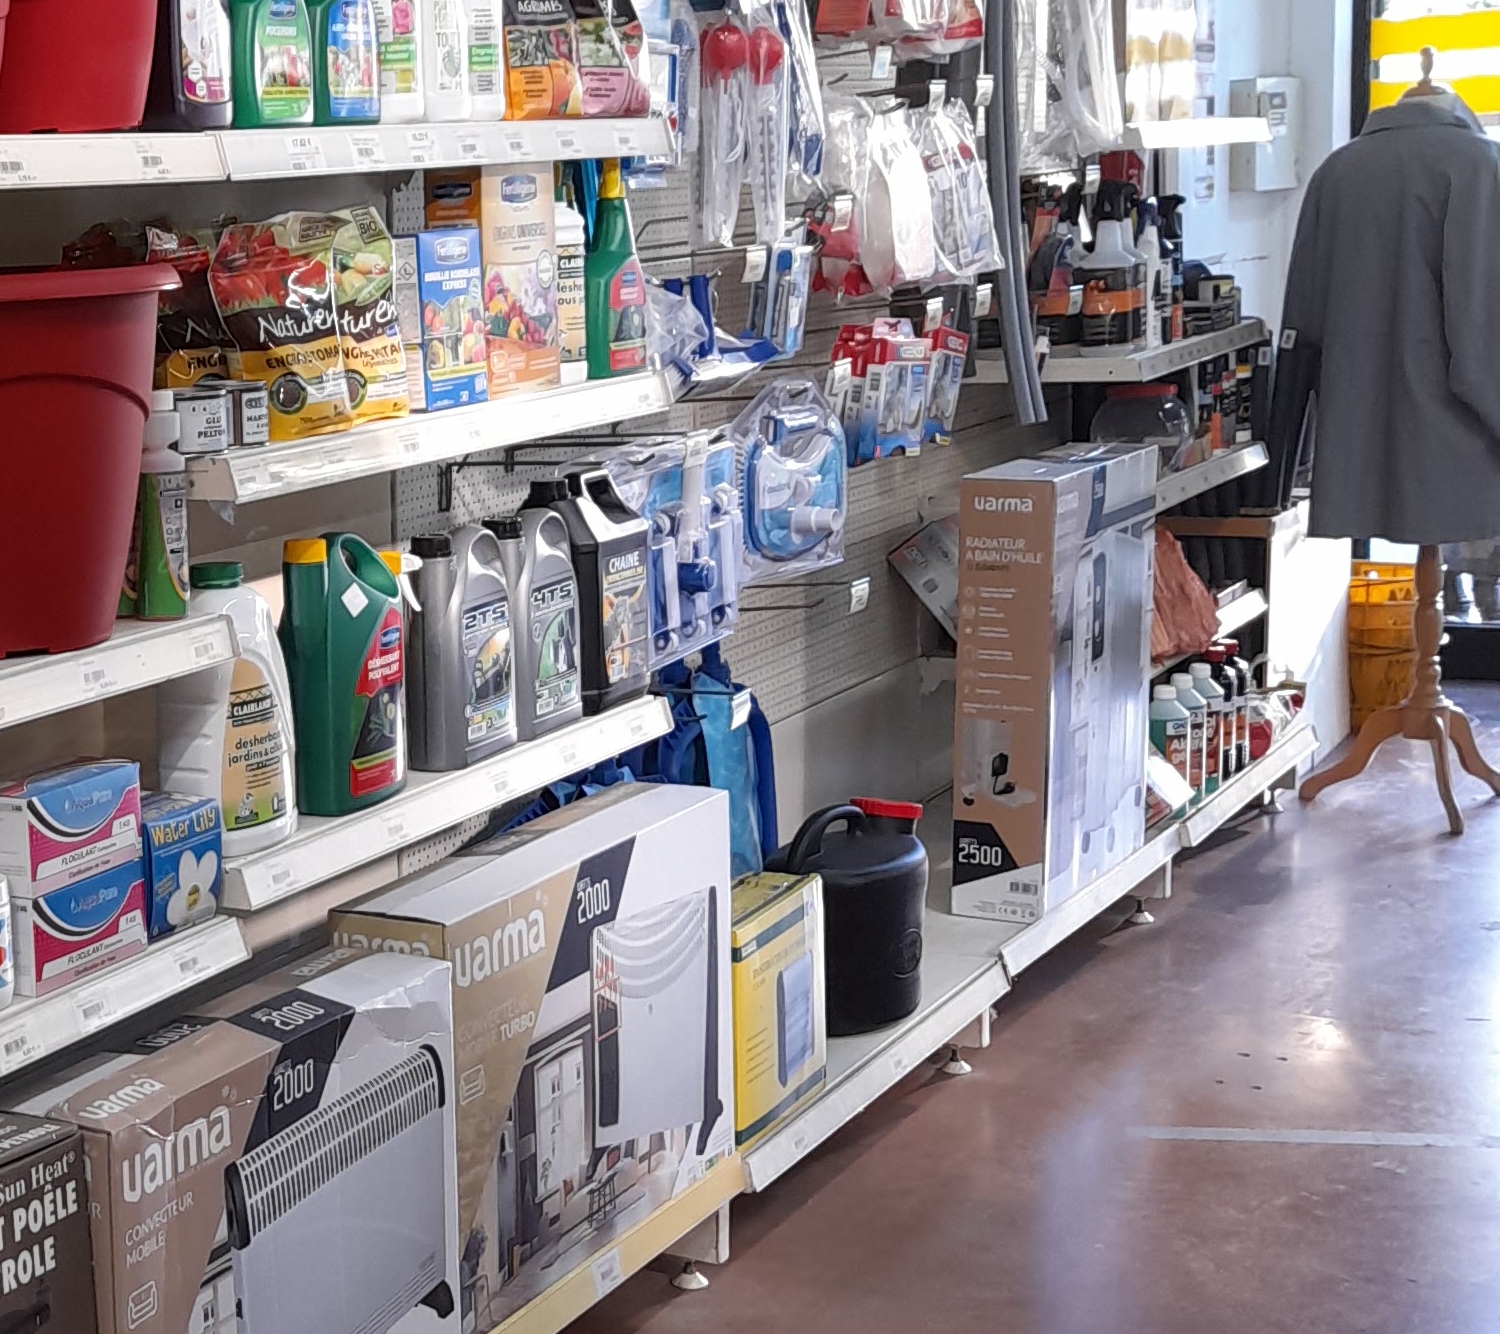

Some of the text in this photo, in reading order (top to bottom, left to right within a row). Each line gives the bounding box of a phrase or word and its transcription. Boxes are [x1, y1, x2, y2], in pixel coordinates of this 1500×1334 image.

[360, 219, 378, 235] BIO
[259, 307, 336, 342] Naturen
[341, 299, 397, 334] turen
[966, 536, 1026, 550] RADIATEUR
[975, 550, 1042, 564] BAIN D'HUILE
[532, 581, 572, 605] 4TS
[464, 603, 507, 630] 2TS
[228, 750, 262, 767] jardins
[151, 808, 216, 844] Water Lily
[958, 845, 1002, 866] 2500
[577, 879, 610, 924] 2000
[261, 1000, 325, 1031] 2000
[500, 1011, 535, 1042] TURBO
[272, 1059, 314, 1111] 2000
[13, 1180, 78, 1242] POÊLE
[125, 1190, 194, 1246] CONVECTEUR
[126, 1231, 166, 1268] MOBILE
